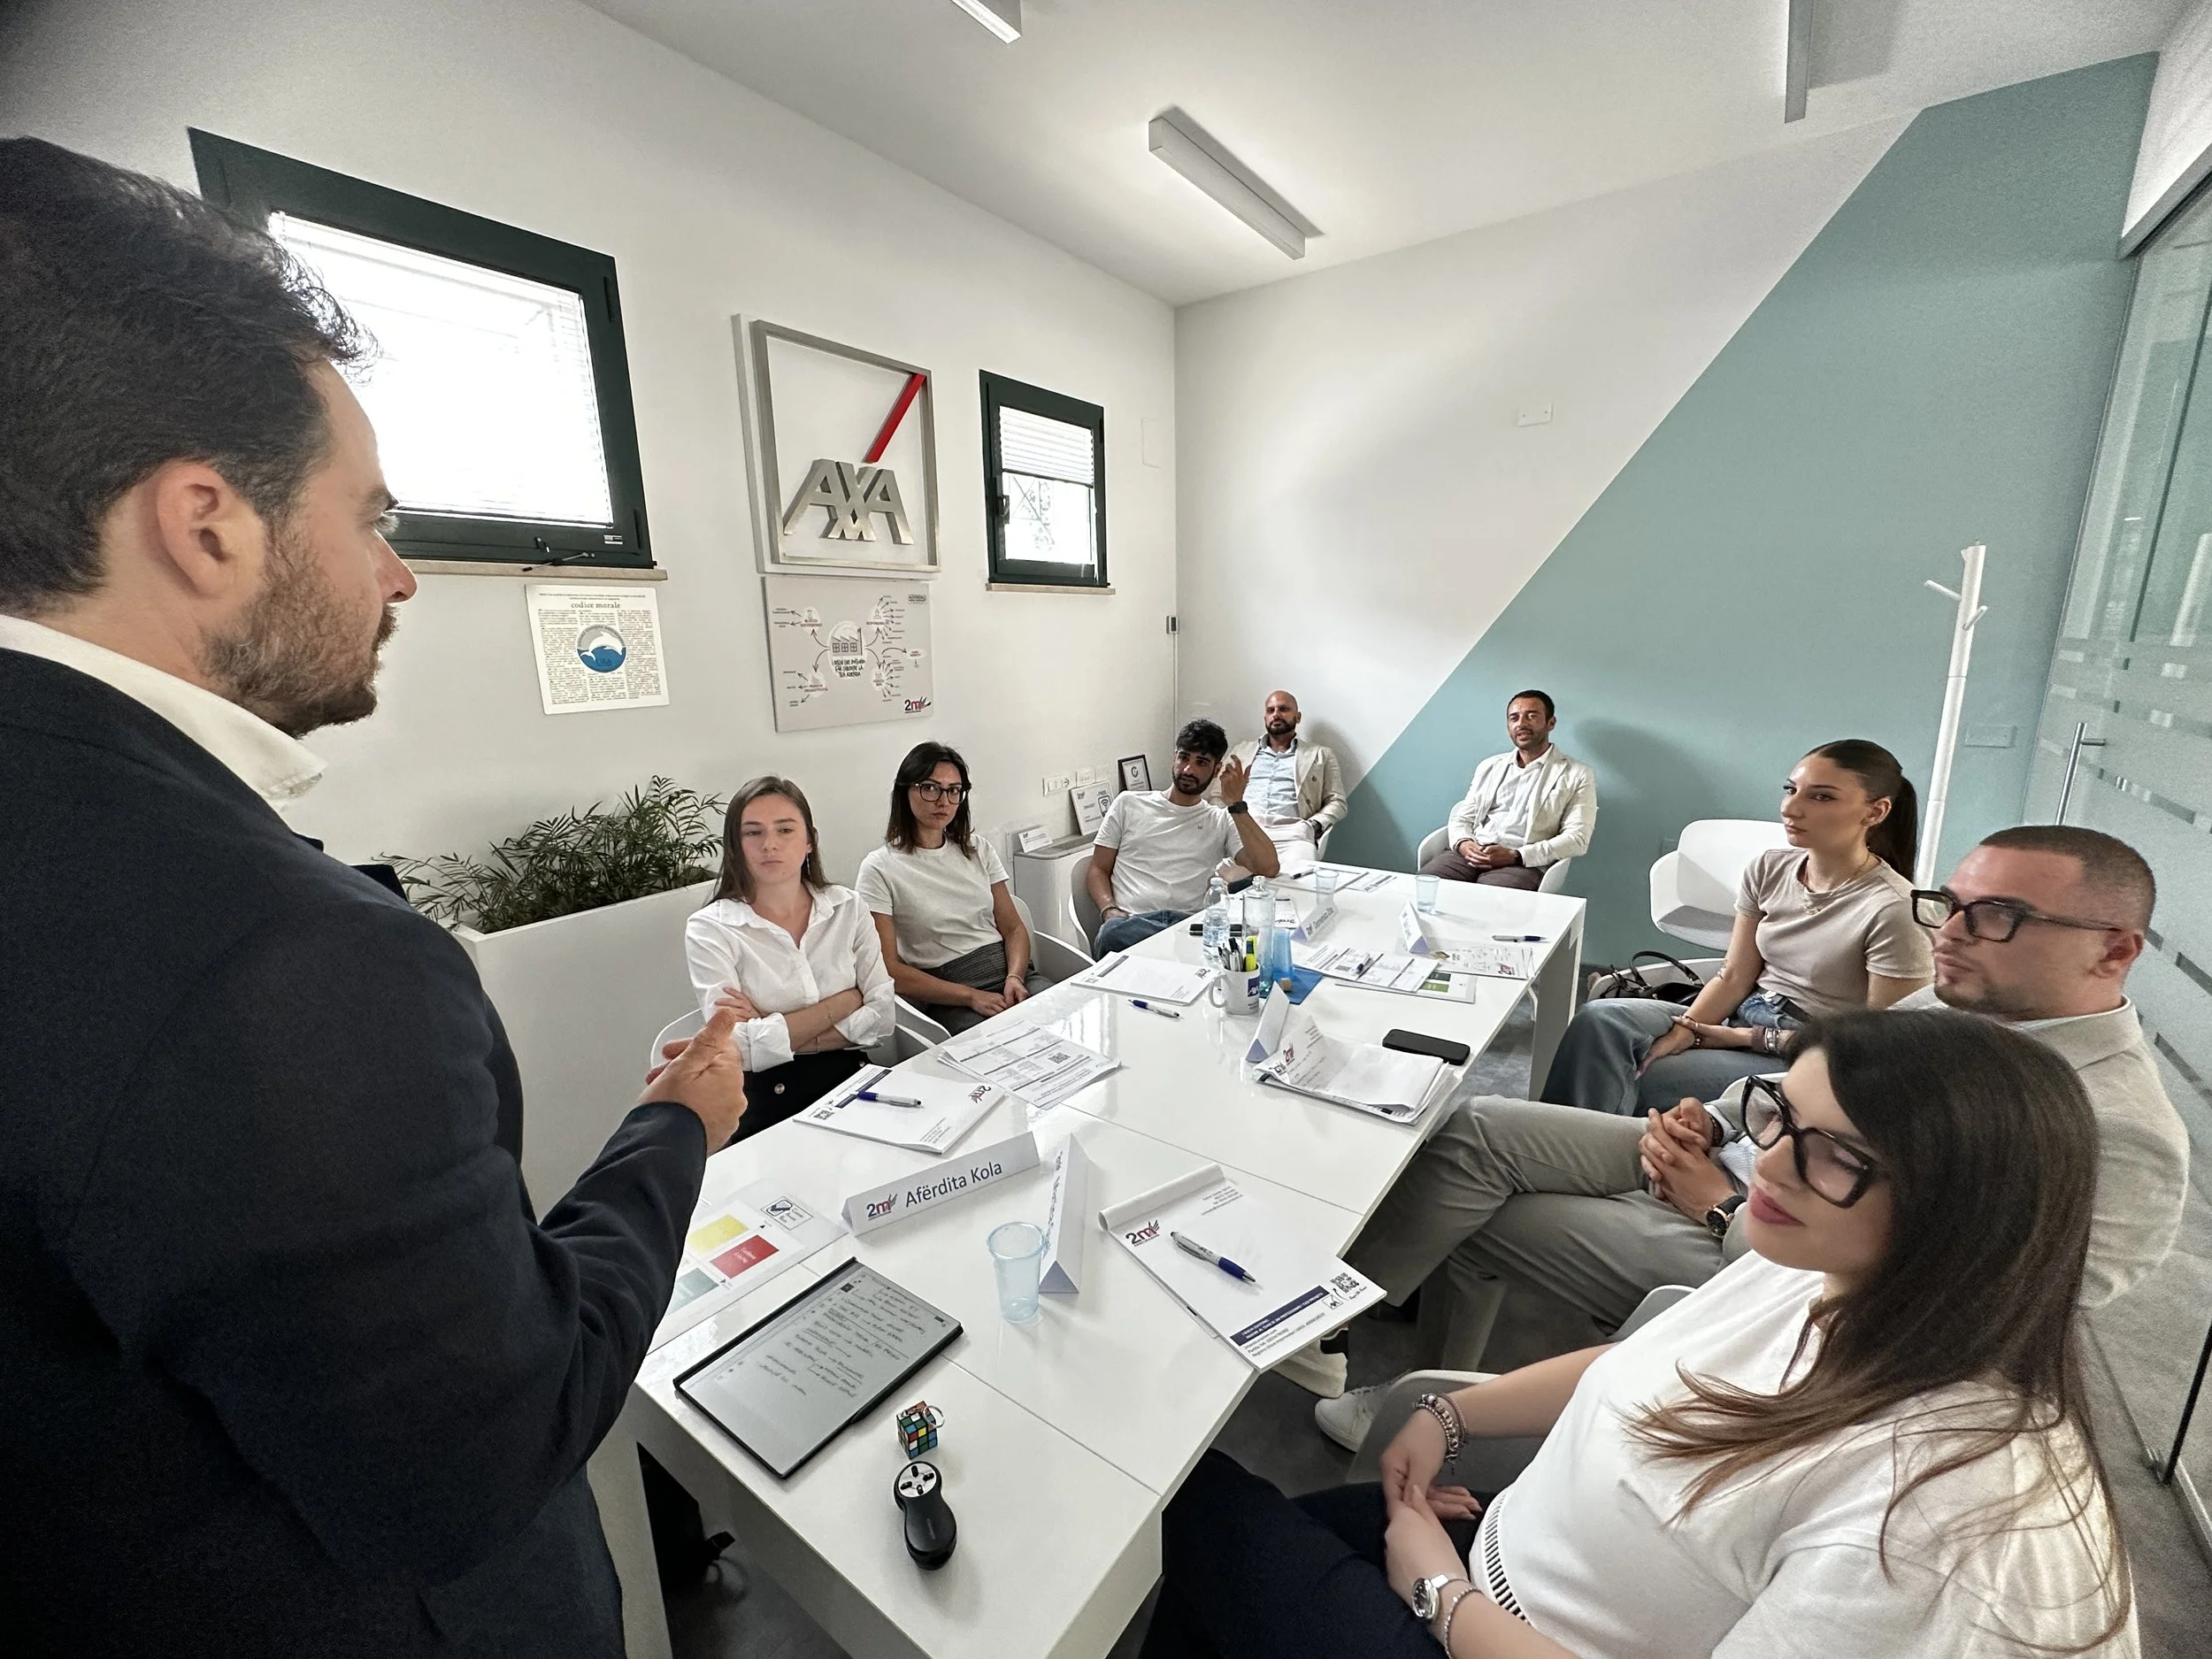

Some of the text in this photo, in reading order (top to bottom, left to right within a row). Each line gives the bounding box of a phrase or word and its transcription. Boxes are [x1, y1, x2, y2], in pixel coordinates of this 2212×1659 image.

[783, 458, 914, 545] AXA
[905, 1175, 967, 1208] Afërdita
[971, 1161, 1002, 1183] Kola
